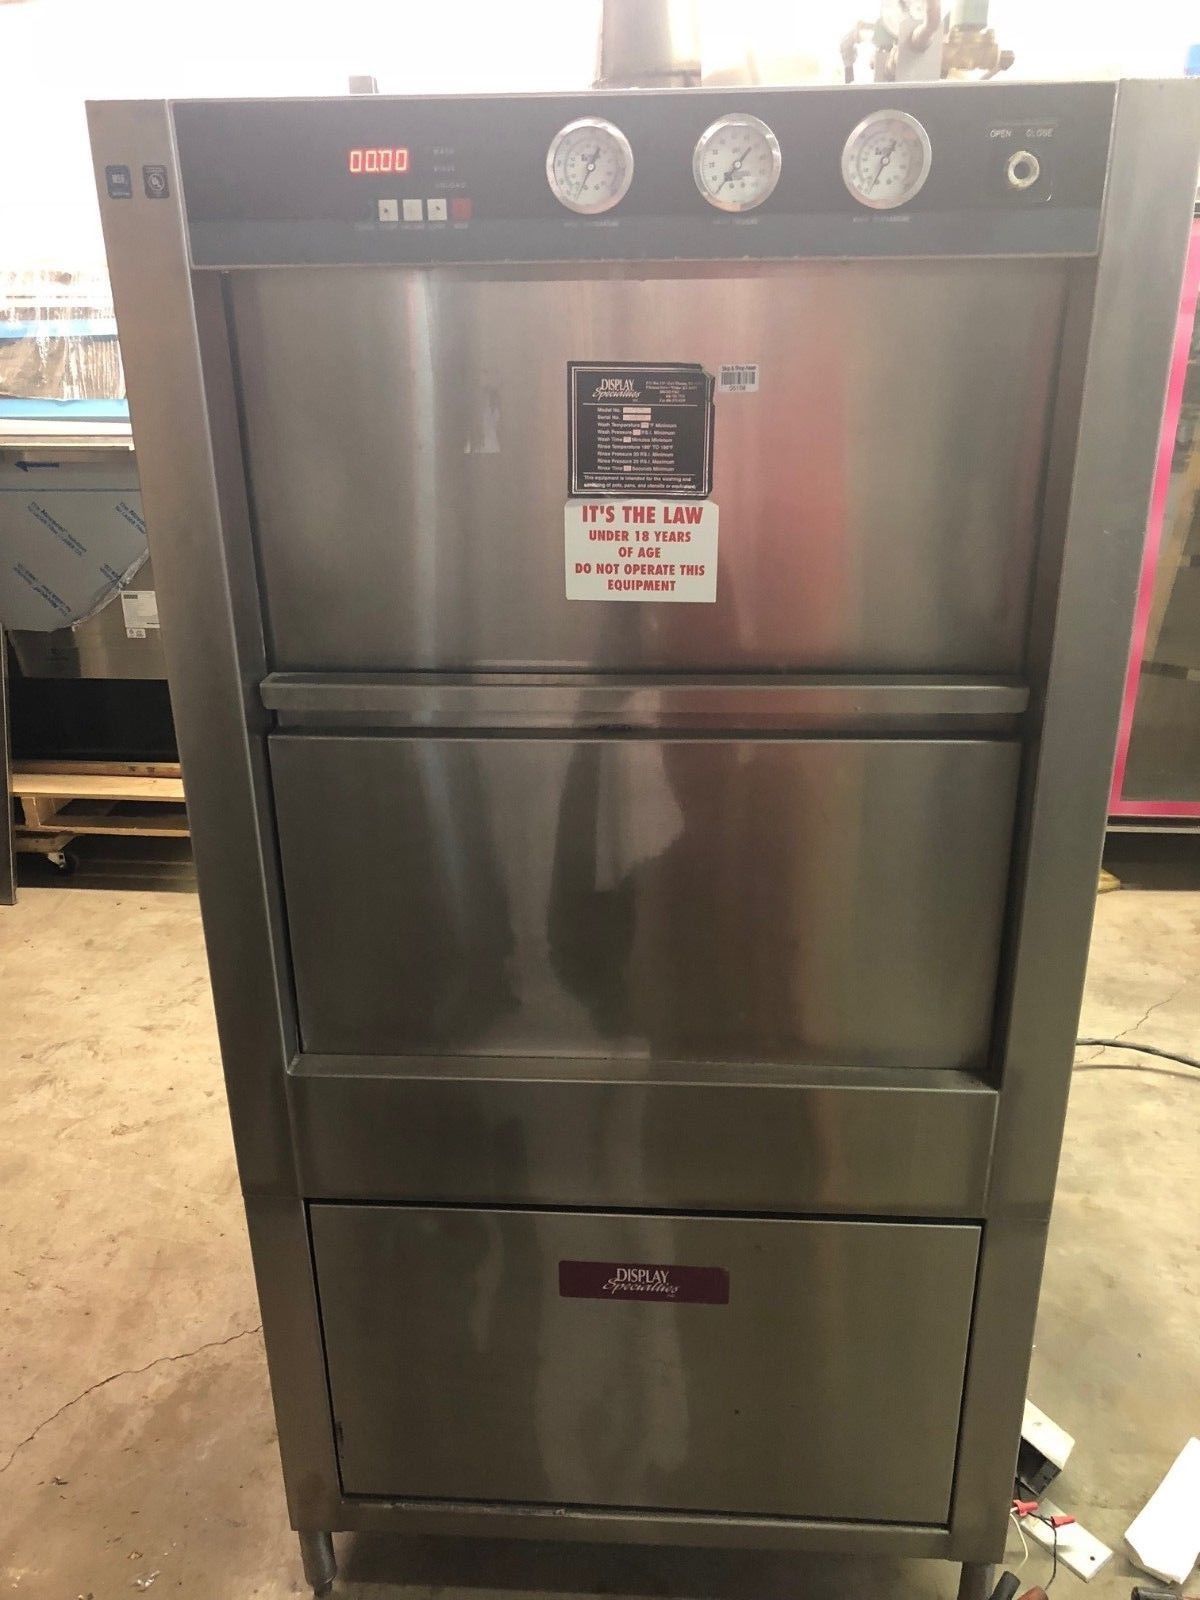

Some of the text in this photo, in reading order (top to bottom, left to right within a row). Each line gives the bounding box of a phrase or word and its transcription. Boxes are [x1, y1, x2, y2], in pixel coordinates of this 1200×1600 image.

[990, 129, 1012, 138] OPEN
[601, 379, 635, 391] DISPLAY
[582, 505, 704, 524] IT'S THE LAW
[589, 530, 692, 543] UNDER 18 YEARS
[618, 547, 661, 559] OF AGE
[575, 563, 705, 576] DO NOT OPERATE THIS
[608, 579, 676, 592] EQUIPMENT
[616, 1268, 670, 1284] DISPLAY
[602, 1278, 679, 1295] Specialties
